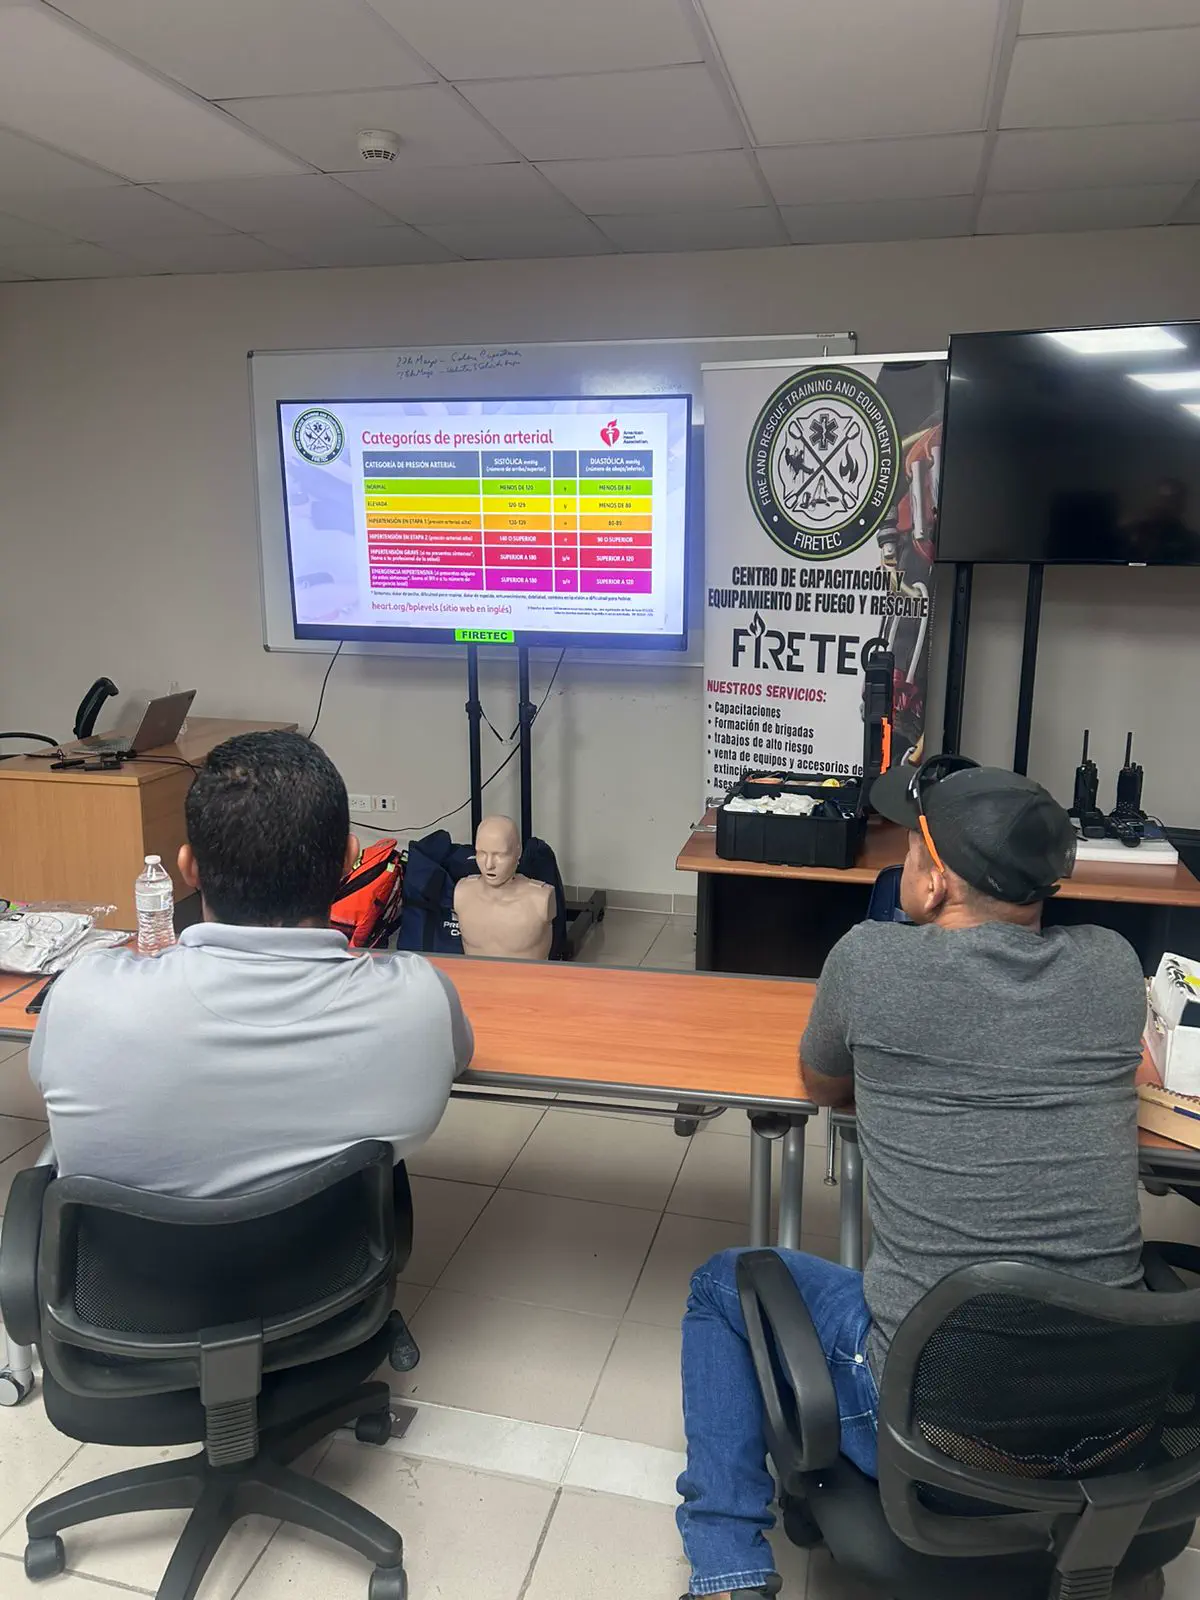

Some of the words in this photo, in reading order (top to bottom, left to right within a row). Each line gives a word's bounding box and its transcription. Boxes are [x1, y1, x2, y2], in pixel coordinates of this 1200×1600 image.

[785, 379, 832, 406] TRAINING
[834, 381, 856, 398] AND
[760, 403, 787, 448] RESCUE
[855, 391, 891, 454] EQUIPMENT
[362, 430, 431, 448] Categorías
[434, 430, 450, 444] de
[454, 429, 500, 448] presión
[504, 429, 553, 444] arterial
[756, 450, 768, 476] AND
[756, 478, 771, 506] FIRE
[871, 458, 891, 508] CENTER
[793, 531, 842, 550] FIRETEC
[732, 566, 778, 586] CENTRO
[781, 568, 796, 588] DE
[800, 566, 891, 591] CAPACITACIÓN
[894, 572, 904, 592] Y
[372, 602, 438, 612] heart.org/bplevels
[440, 604, 458, 612] (sitio
[460, 604, 475, 612] web
[487, 605, 512, 615] inglés)
[708, 588, 791, 611] EQUIPAMIENTO
[795, 593, 811, 612] DE
[815, 593, 854, 614] FUEGO
[858, 595, 868, 614] Y
[870, 595, 928, 618] RESCATE
[462, 631, 508, 640] FIRETEC
[732, 612, 889, 676] FIRETEC
[707, 680, 762, 696] NUESTROS
[766, 685, 827, 703] SERVICIOS:
[715, 701, 781, 718] Capacitaciones
[715, 717, 759, 732] Formación
[762, 722, 773, 733] de
[775, 724, 814, 738] brigadas
[715, 732, 750, 746] trabajos
[753, 736, 763, 748] de
[766, 738, 782, 751] alto
[785, 741, 813, 755] riesgo
[740, 750, 750, 761] de
[753, 752, 787, 767] equipos
[790, 758, 794, 769] y
[797, 759, 849, 774] accesorios
[852, 764, 863, 776] de
